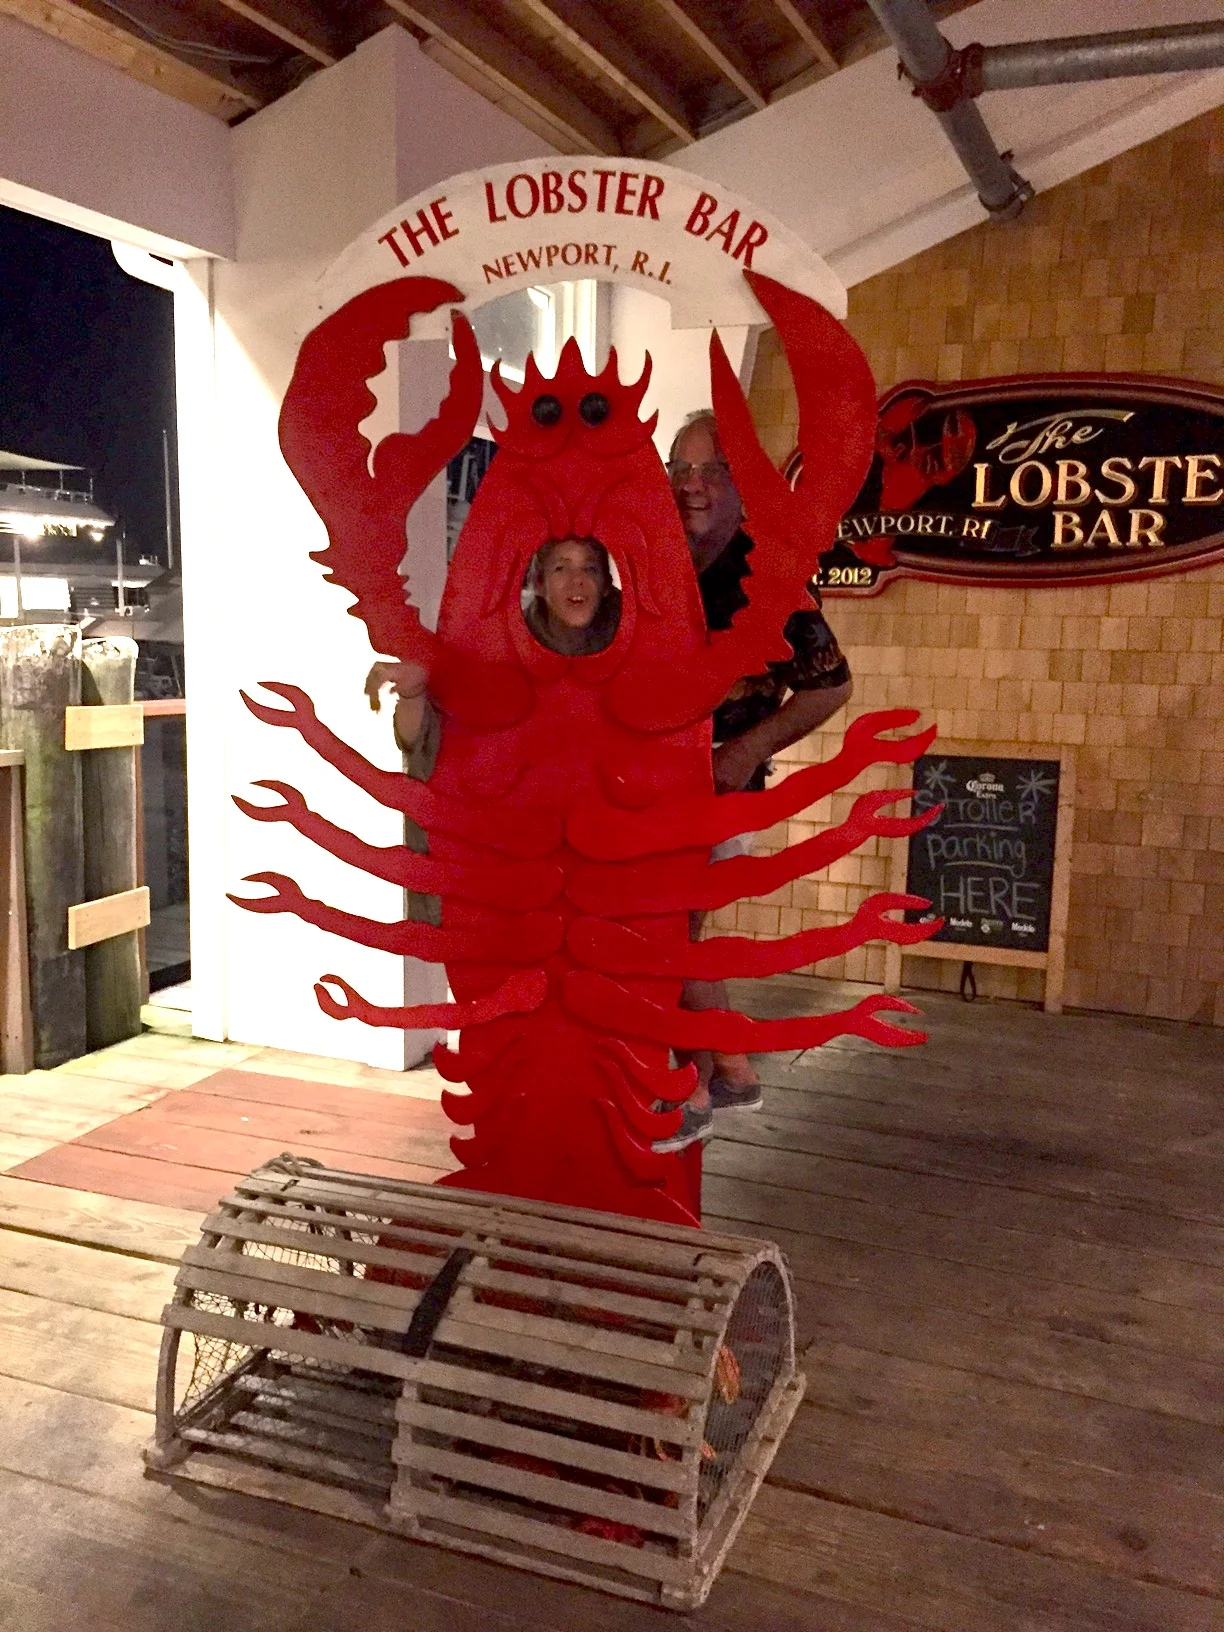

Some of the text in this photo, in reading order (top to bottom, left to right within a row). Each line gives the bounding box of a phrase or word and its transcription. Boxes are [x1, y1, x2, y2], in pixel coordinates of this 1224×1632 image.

[378, 170, 769, 269] THE LOBSTER BAR
[483, 243, 673, 285] NEWPORT, R.I.
[986, 410, 1136, 464] The
[971, 455, 1224, 507] LOBSTE
[836, 514, 992, 540] EWPORT, RI
[1050, 508, 1166, 549] BAR
[828, 566, 872, 585] 2012
[966, 779, 1004, 792] Corona
[940, 874, 1040, 921] HERE
